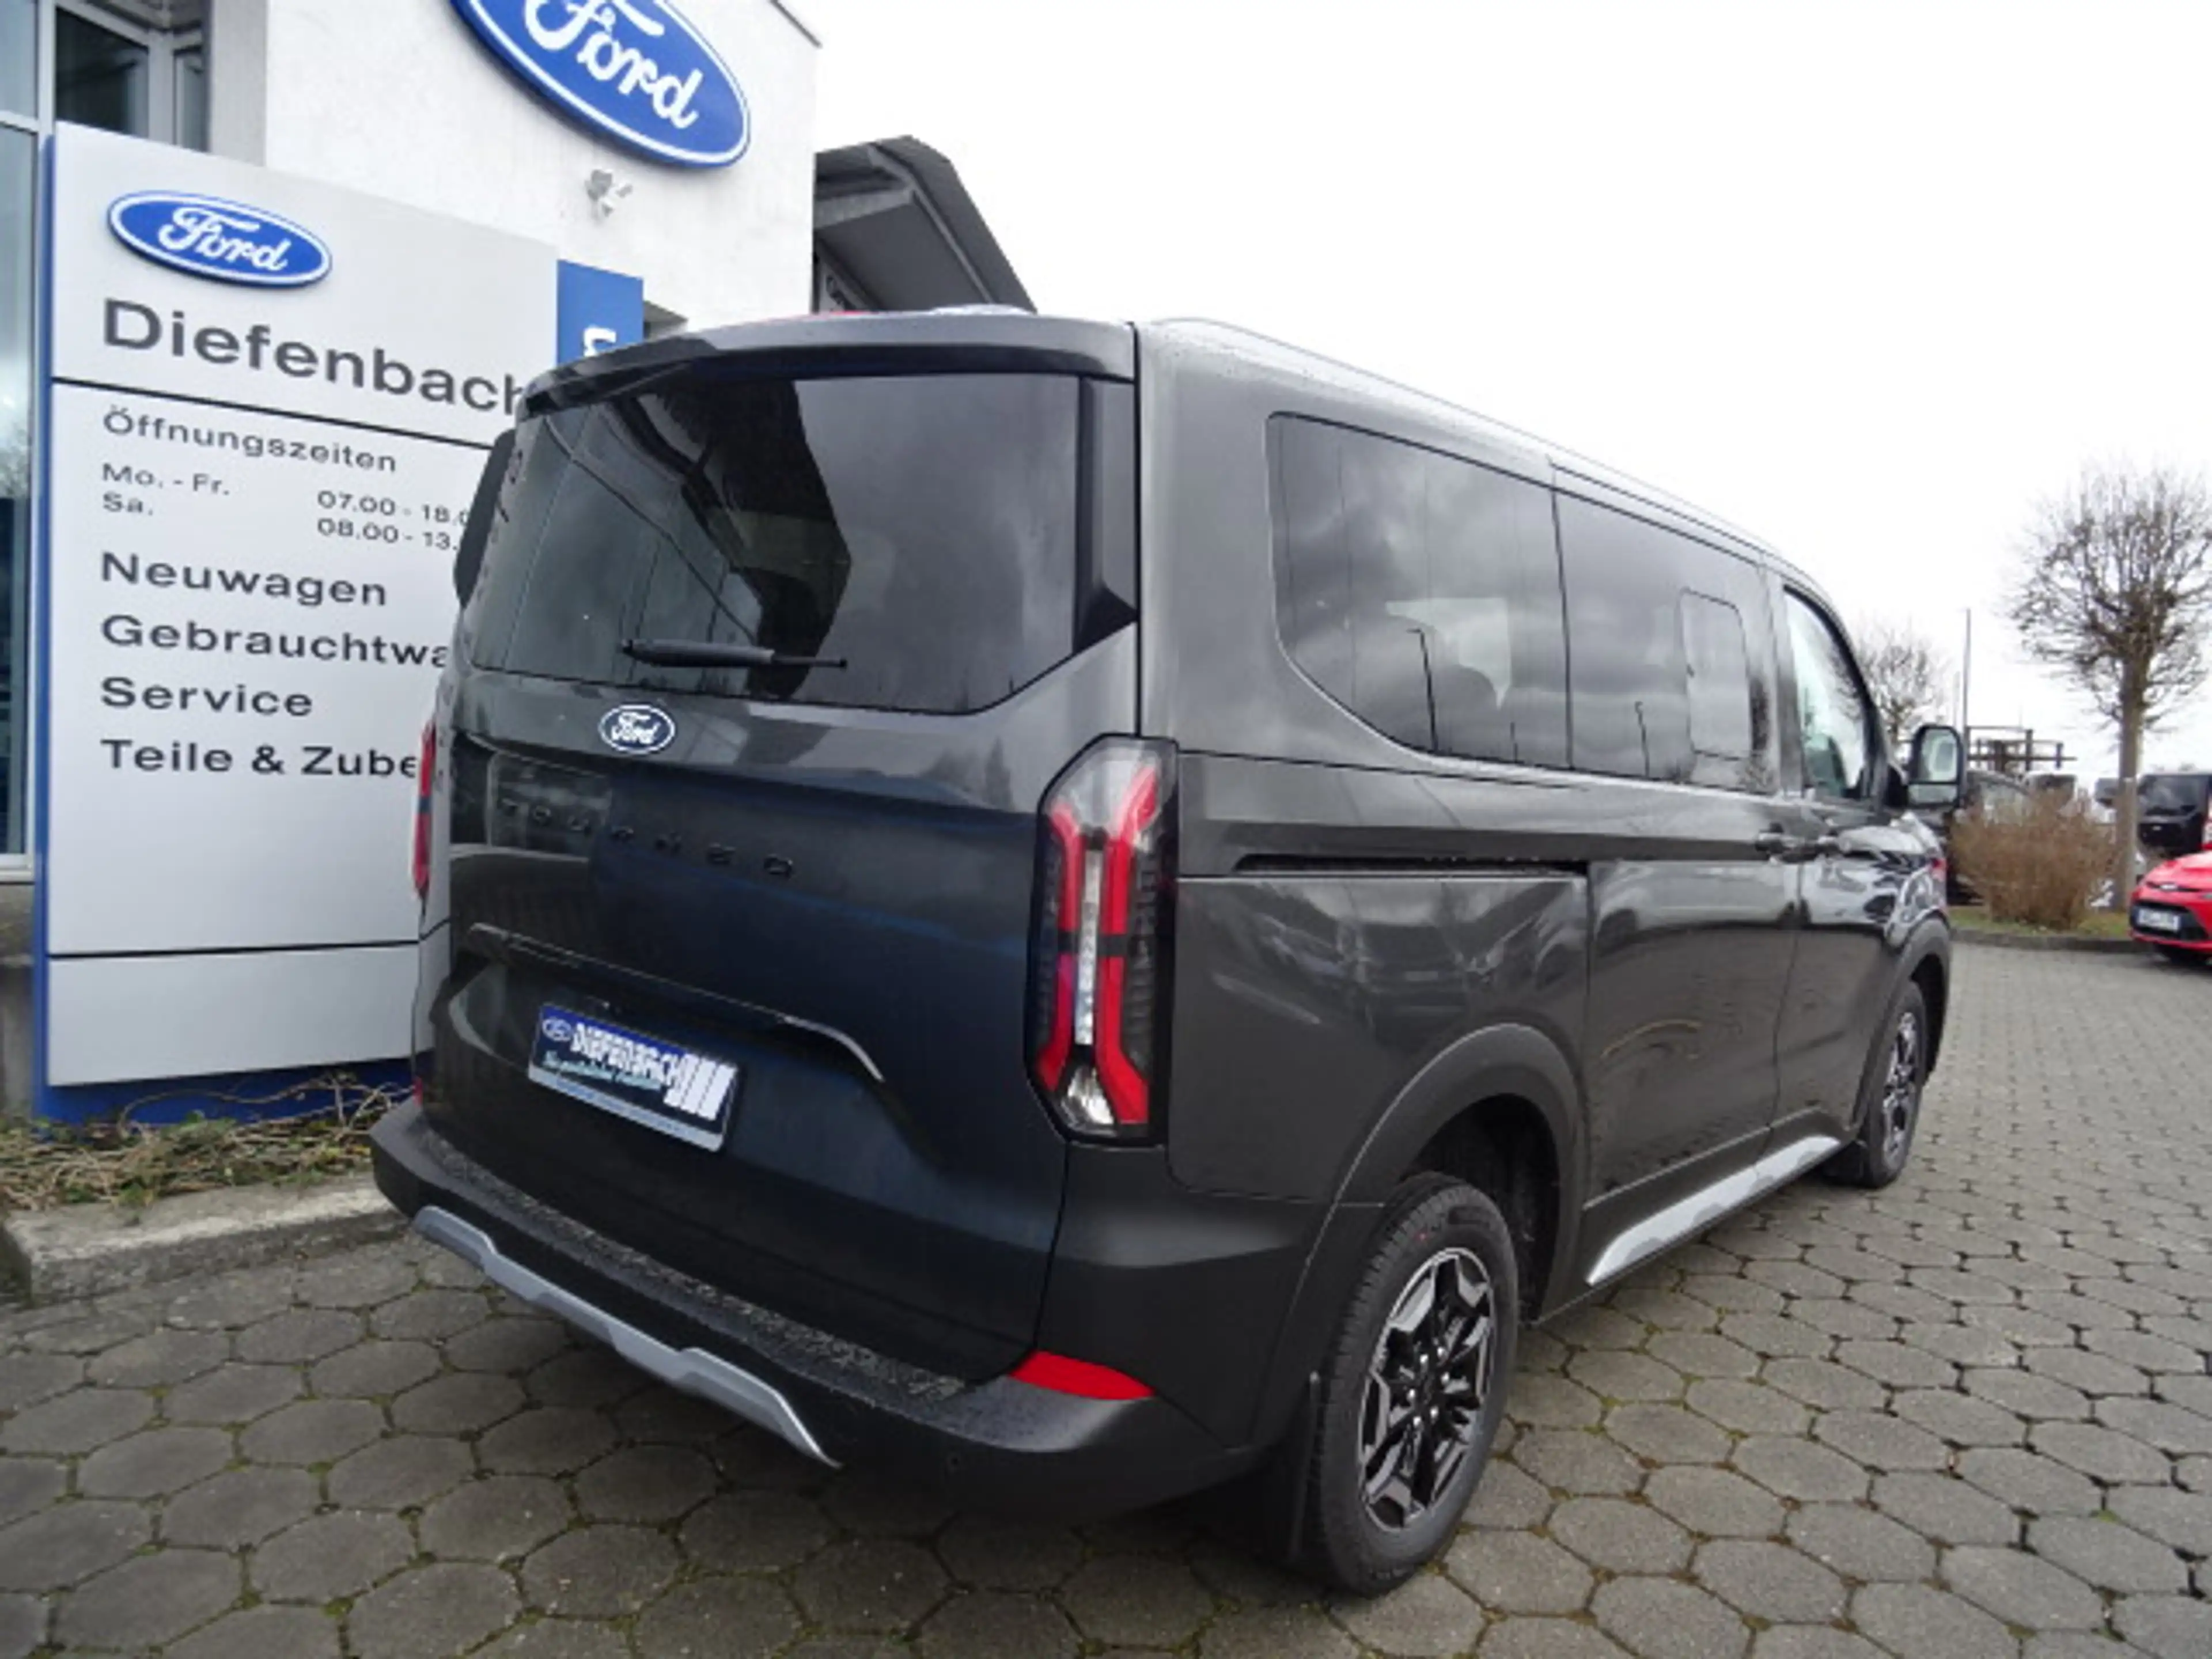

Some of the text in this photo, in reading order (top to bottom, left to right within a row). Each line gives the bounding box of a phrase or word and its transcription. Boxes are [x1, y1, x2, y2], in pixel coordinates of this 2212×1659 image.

[525, 0, 703, 129] Ford
[158, 207, 291, 271] Ford
[103, 404, 396, 474] Öffnungszeiten
[102, 463, 163, 489] Mo.
[192, 473, 229, 495] Fr.
[103, 491, 153, 516] Sa.
[317, 490, 396, 516] 07.00
[317, 517, 399, 544] 08.00
[101, 551, 387, 607] Neuwagen
[100, 614, 448, 668] Gebrauchtwa
[100, 676, 312, 717] Service
[611, 712, 661, 744] Ford
[100, 738, 417, 779] Teile & Zube
